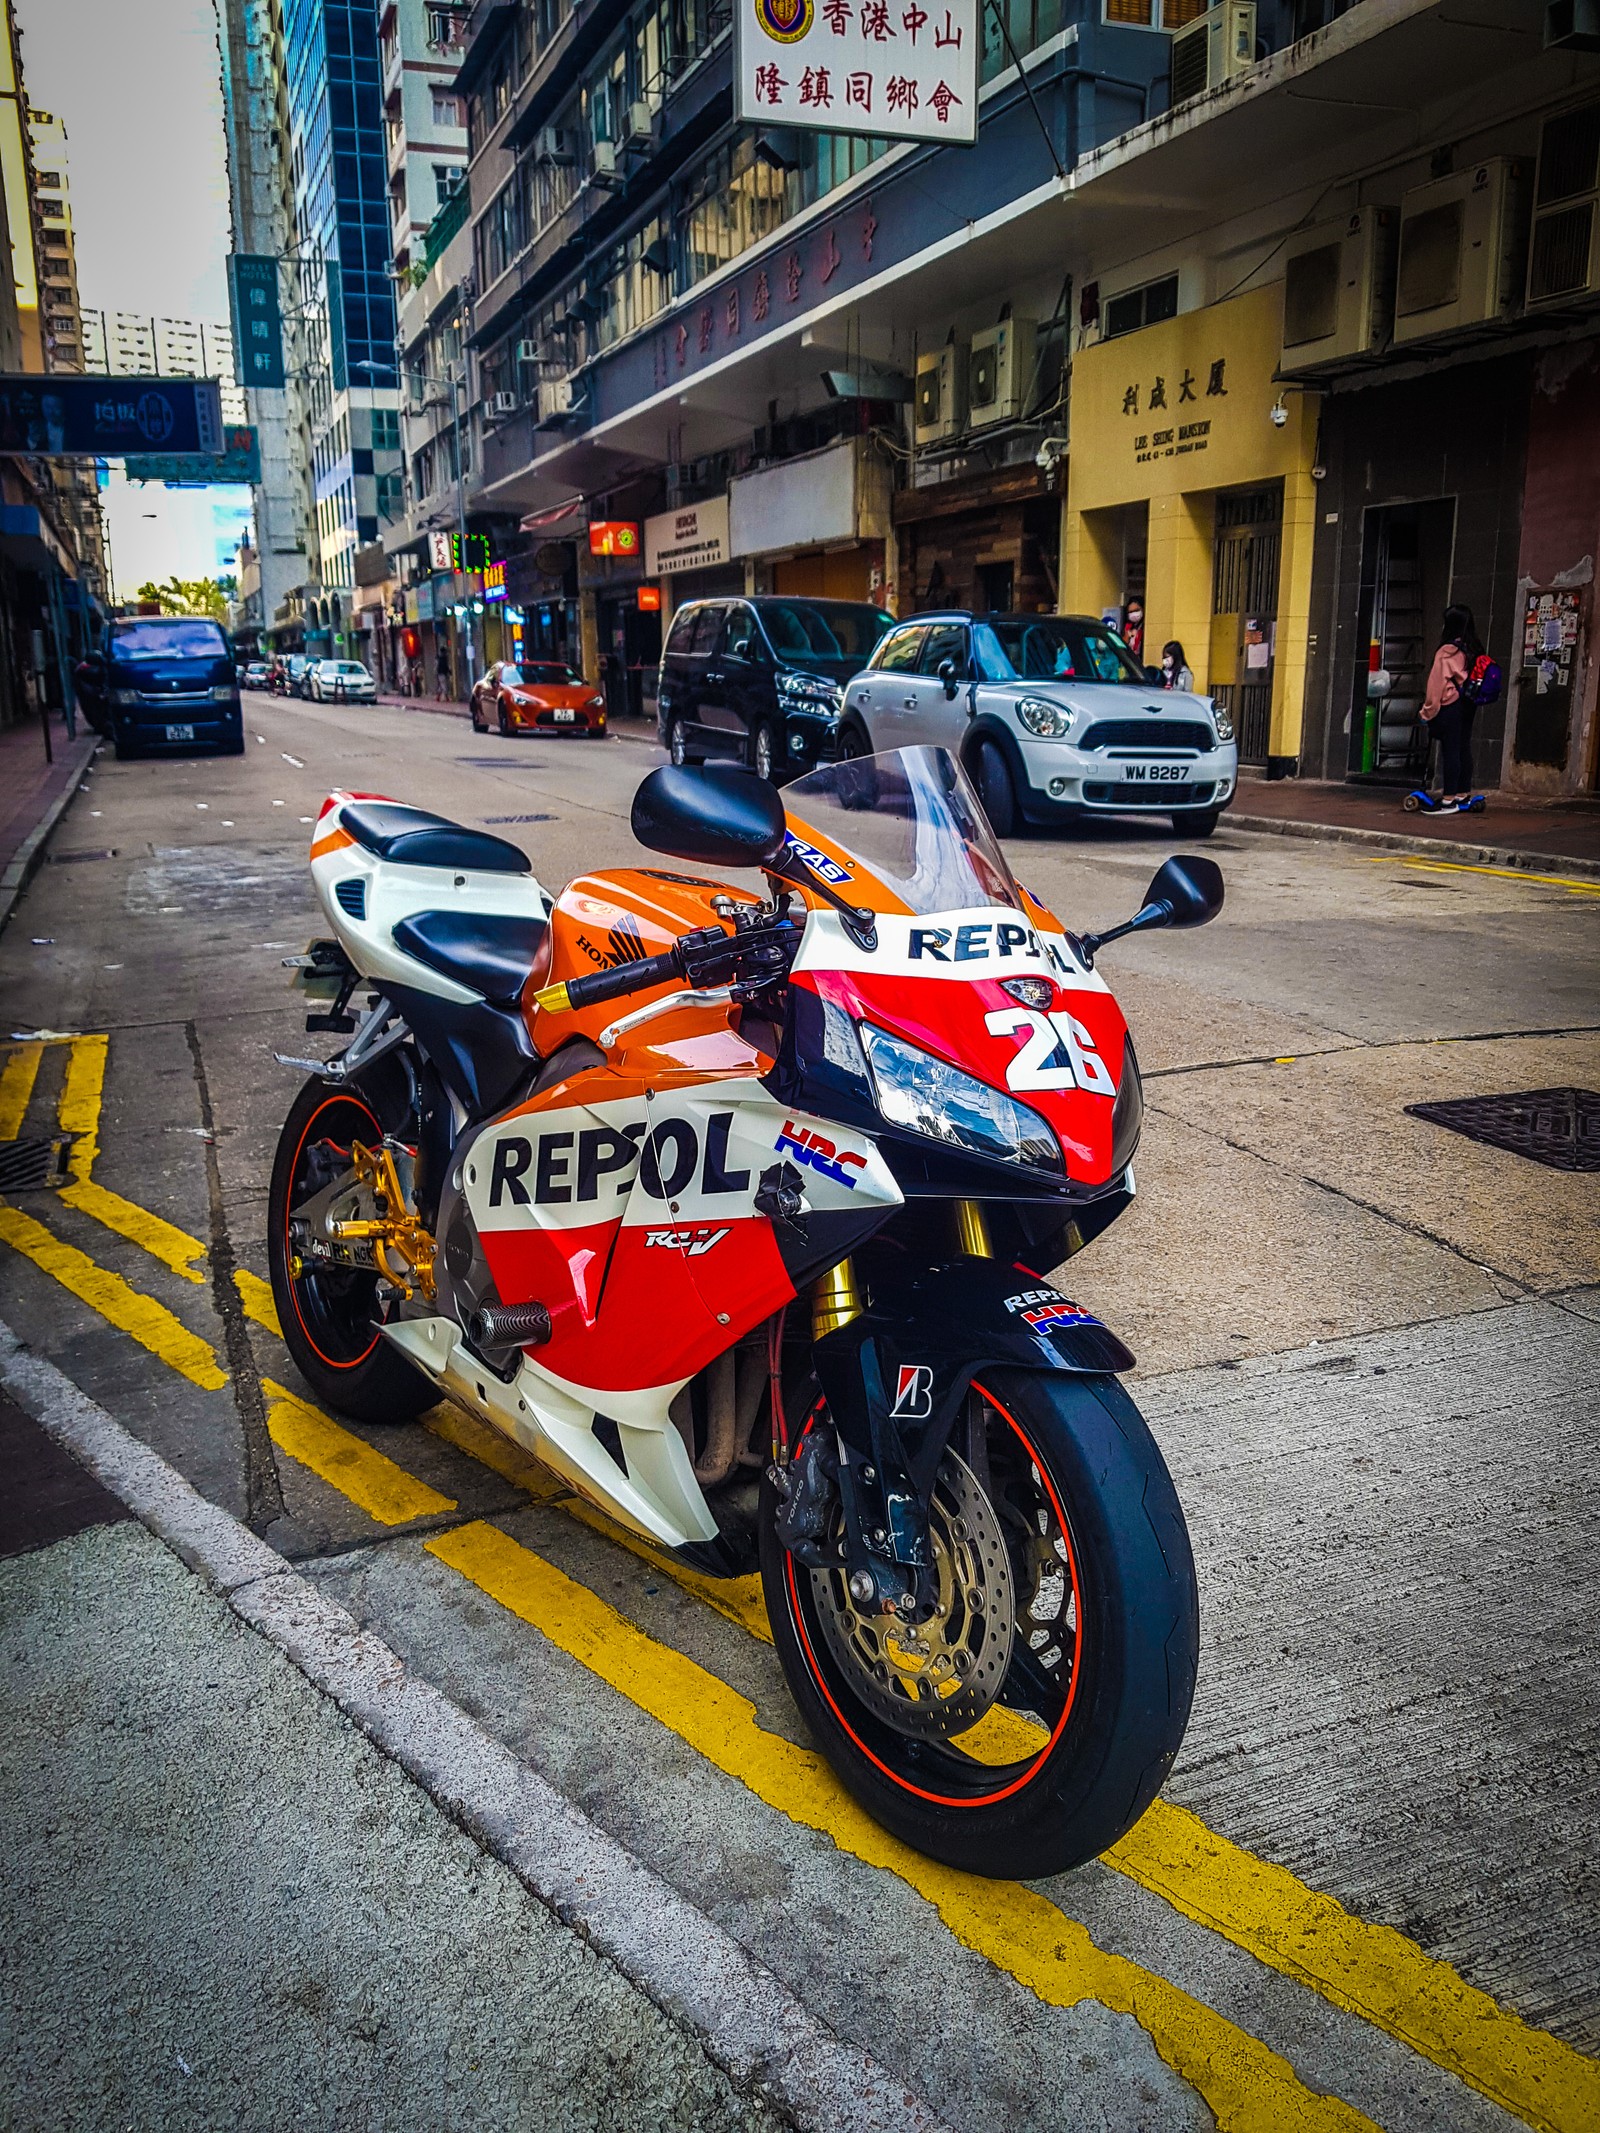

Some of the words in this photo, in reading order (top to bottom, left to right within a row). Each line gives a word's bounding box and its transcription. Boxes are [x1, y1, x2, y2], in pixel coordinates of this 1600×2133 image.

[822, 0, 963, 50] 香港中山
[755, 62, 964, 123] 隆鎮同鄉會
[1134, 435, 1148, 450] LEE
[1153, 428, 1174, 446] SHING
[1178, 420, 1211, 440] MANSION
[1125, 766, 1146, 780] WM
[1150, 766, 1190, 780] 8287
[786, 839, 844, 880] GAS
[984, 1007, 1117, 1098] 26
[489, 1111, 751, 1207] REPSOL
[774, 1119, 868, 1191] HRC
[786, 1479, 804, 1525] TOKICO
